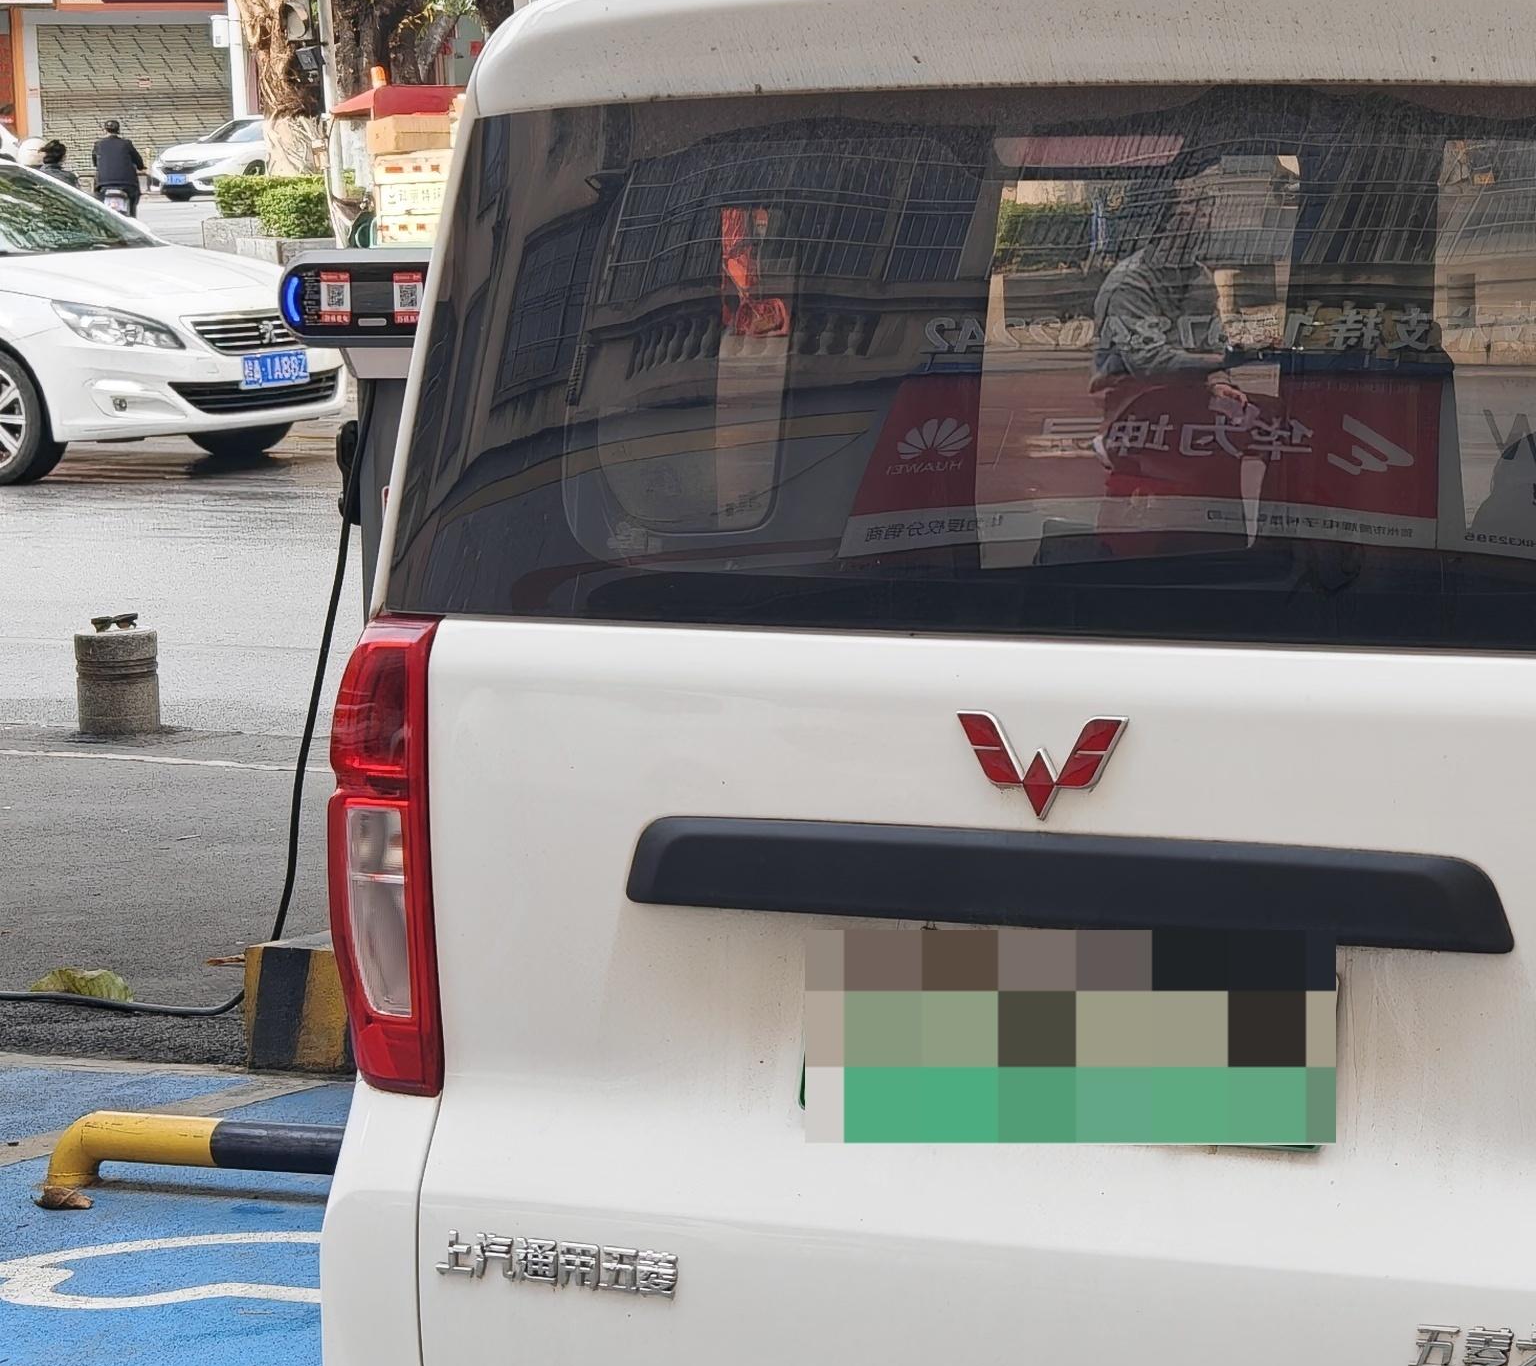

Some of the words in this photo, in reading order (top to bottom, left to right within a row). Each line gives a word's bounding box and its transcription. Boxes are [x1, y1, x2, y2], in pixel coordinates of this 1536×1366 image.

[435, 1228, 680, 1302] 上汽通用五菱
